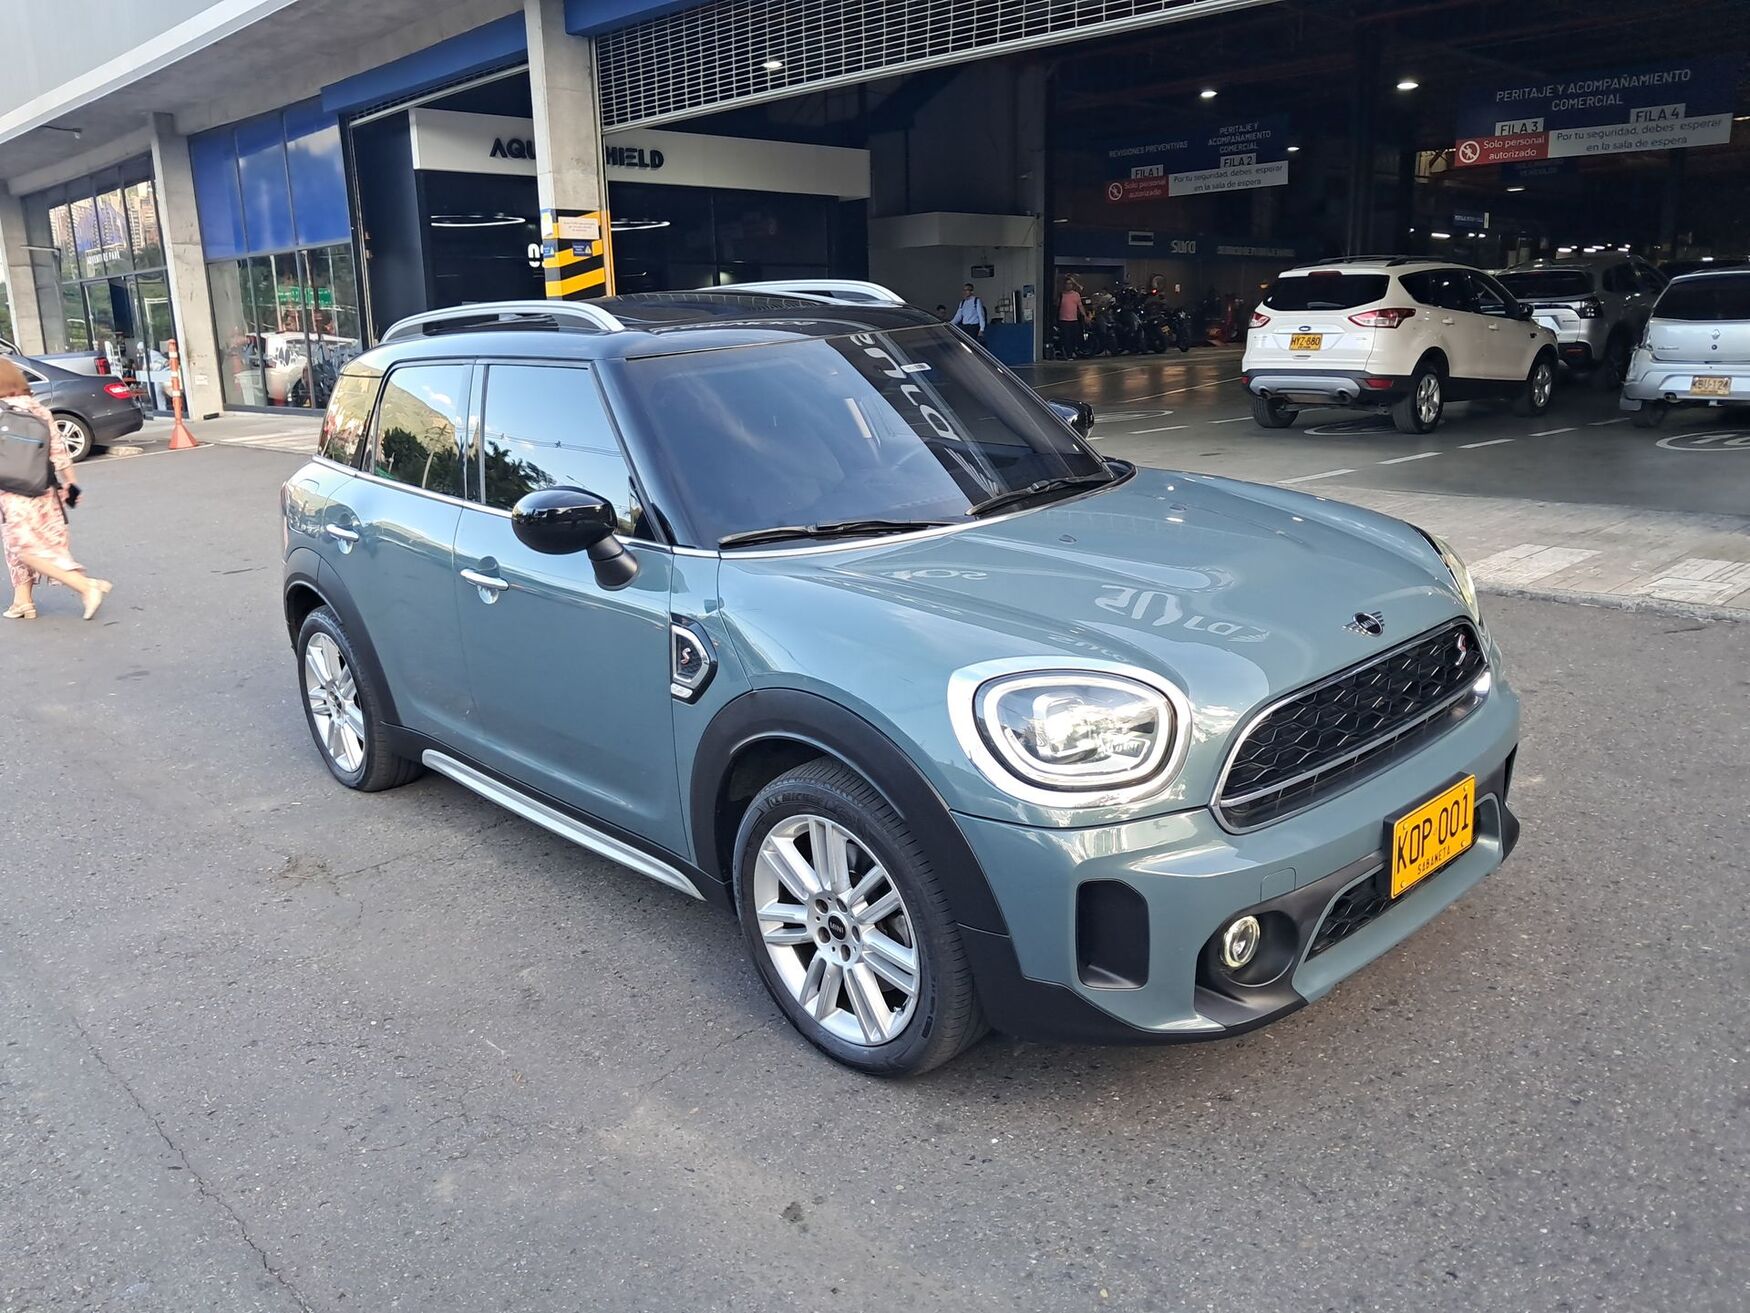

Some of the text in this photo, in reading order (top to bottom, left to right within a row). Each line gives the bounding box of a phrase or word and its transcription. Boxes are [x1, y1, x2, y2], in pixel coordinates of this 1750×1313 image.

[1496, 69, 1691, 102] PERITAJE Y ACOMPAÑAMIENTO
[1551, 94, 1624, 111] COMERCIAL
[1635, 106, 1680, 122] FILA 4
[1219, 123, 1253, 135] PERITAJE
[1500, 120, 1538, 136] FILA 3
[1556, 118, 1722, 142] Por tu seguridad, debes esperar
[1208, 130, 1272, 146] ACOMPAÑAMIENTO
[1483, 136, 1545, 149] Solo personal
[1586, 136, 1688, 152] en la sala de espera
[489, 137, 664, 169] AQU HIELD
[1145, 140, 1189, 153] PREVENTIVAS
[1219, 141, 1259, 154] COMERCIAL
[1488, 147, 1537, 160] autorizado
[1223, 156, 1253, 167] FILA 2
[1135, 168, 1154, 178] FILA
[528, 243, 544, 268] 0
[1397, 793, 1469, 874] KOP 001
[1417, 845, 1451, 875] SABANETA
